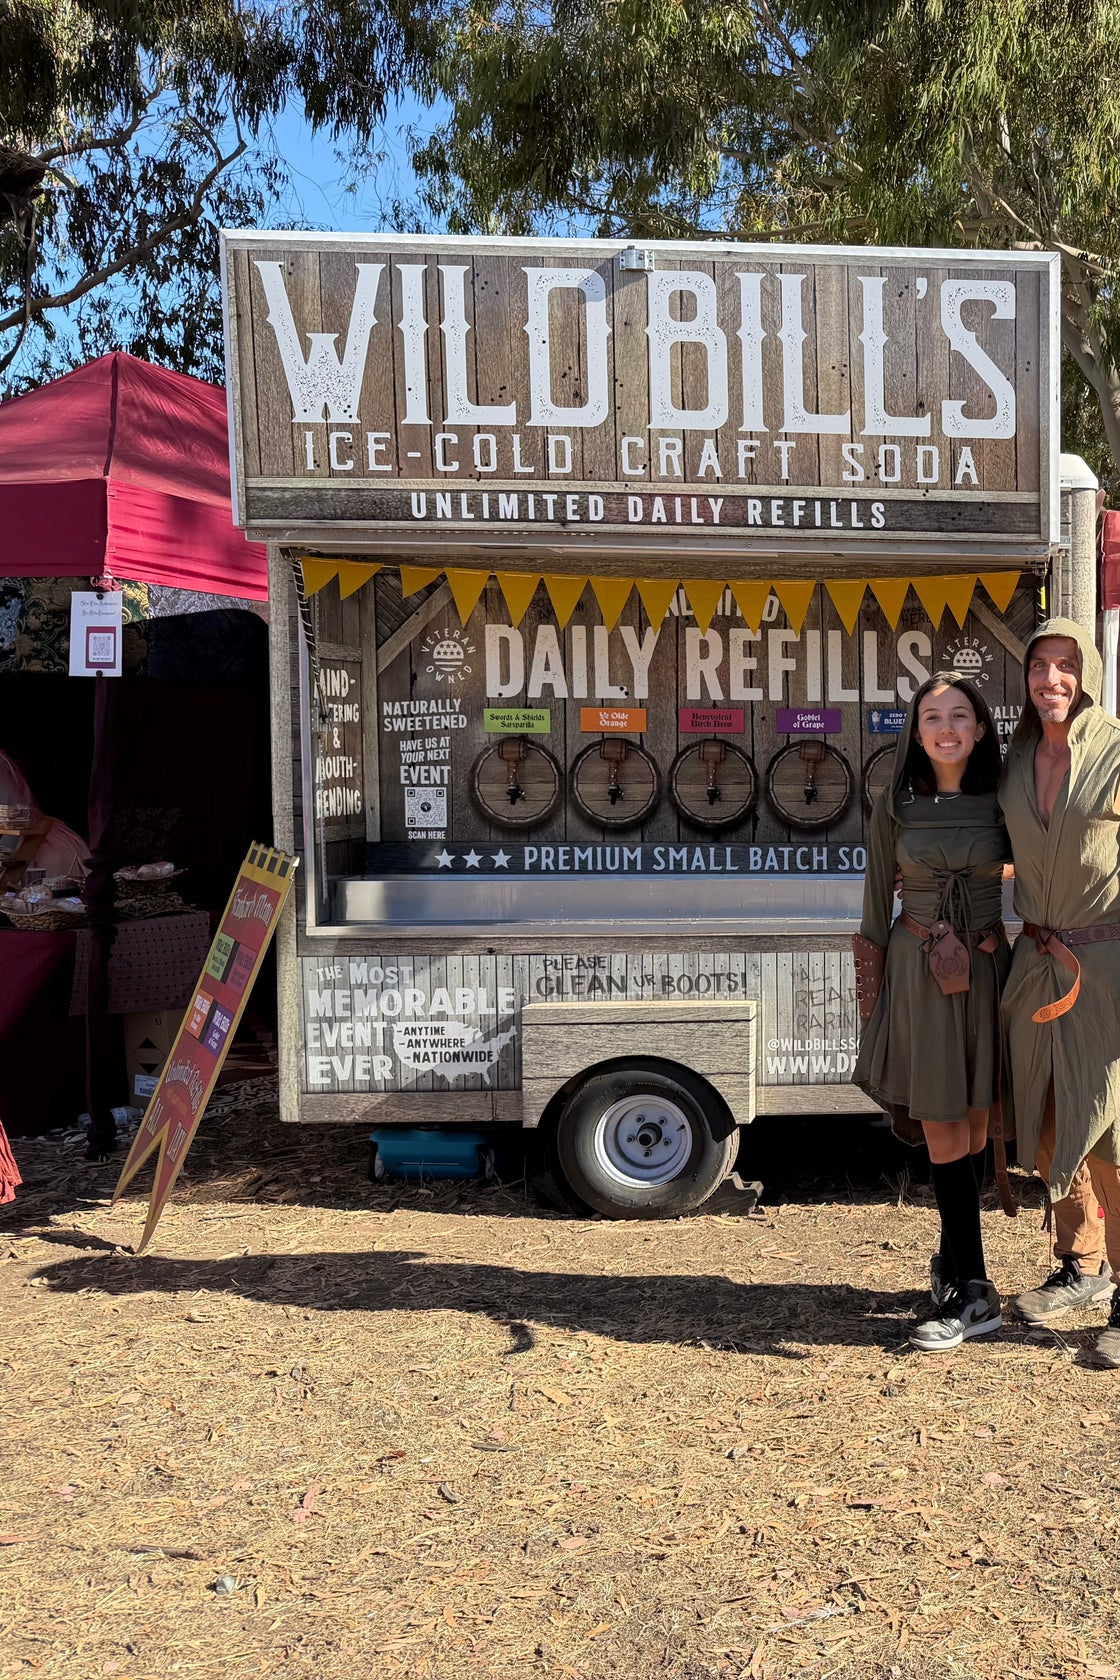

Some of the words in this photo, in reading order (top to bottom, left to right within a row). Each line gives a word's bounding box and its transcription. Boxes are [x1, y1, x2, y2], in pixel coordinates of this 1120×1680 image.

[254, 260, 612, 428] WILD
[645, 269, 1016, 440] BILL'S
[304, 430, 572, 475] ICE-COLD
[621, 436, 797, 481] CRAFT
[842, 442, 981, 486] SODA
[410, 491, 604, 522] UNLIMITED
[627, 495, 724, 525] DAILY
[748, 499, 886, 529] REFILLS
[421, 628, 477, 654] VETERAN
[941, 636, 994, 663] VETERAN
[484, 623, 661, 699] DAILY
[685, 627, 931, 703] REFILLS
[426, 665, 472, 684] OWNED
[328, 703, 360, 723] ERING
[383, 698, 461, 716] NATURALLY
[522, 713, 545, 721] Shields
[797, 713, 821, 721] Goblet
[383, 714, 468, 732] SWEETENED
[599, 719, 628, 728] Orange
[713, 720, 733, 728] Brew
[802, 720, 825, 729] Grape
[332, 727, 341, 749] &
[400, 739, 423, 752] HAVE
[425, 737, 438, 749] US
[439, 736, 451, 748] AT
[400, 750, 425, 764] YOUR
[427, 748, 450, 761] NEXT
[400, 765, 451, 785] EVENT
[407, 830, 426, 840] SCAN
[428, 830, 446, 840] HERE
[524, 846, 642, 871] PREMIUM
[652, 846, 739, 871] SMALL
[749, 846, 828, 871] BATCH
[837, 846, 867, 871] SO
[316, 965, 343, 982] THE
[349, 962, 414, 984] MOST
[542, 955, 608, 972] PLEASE
[536, 973, 627, 997] CLEAN
[634, 973, 656, 989] UR
[661, 972, 747, 995] BOOTS!
[308, 986, 515, 1017] MEMORABLE
[307, 1021, 387, 1048] EVENT
[308, 1055, 393, 1084] EVER
